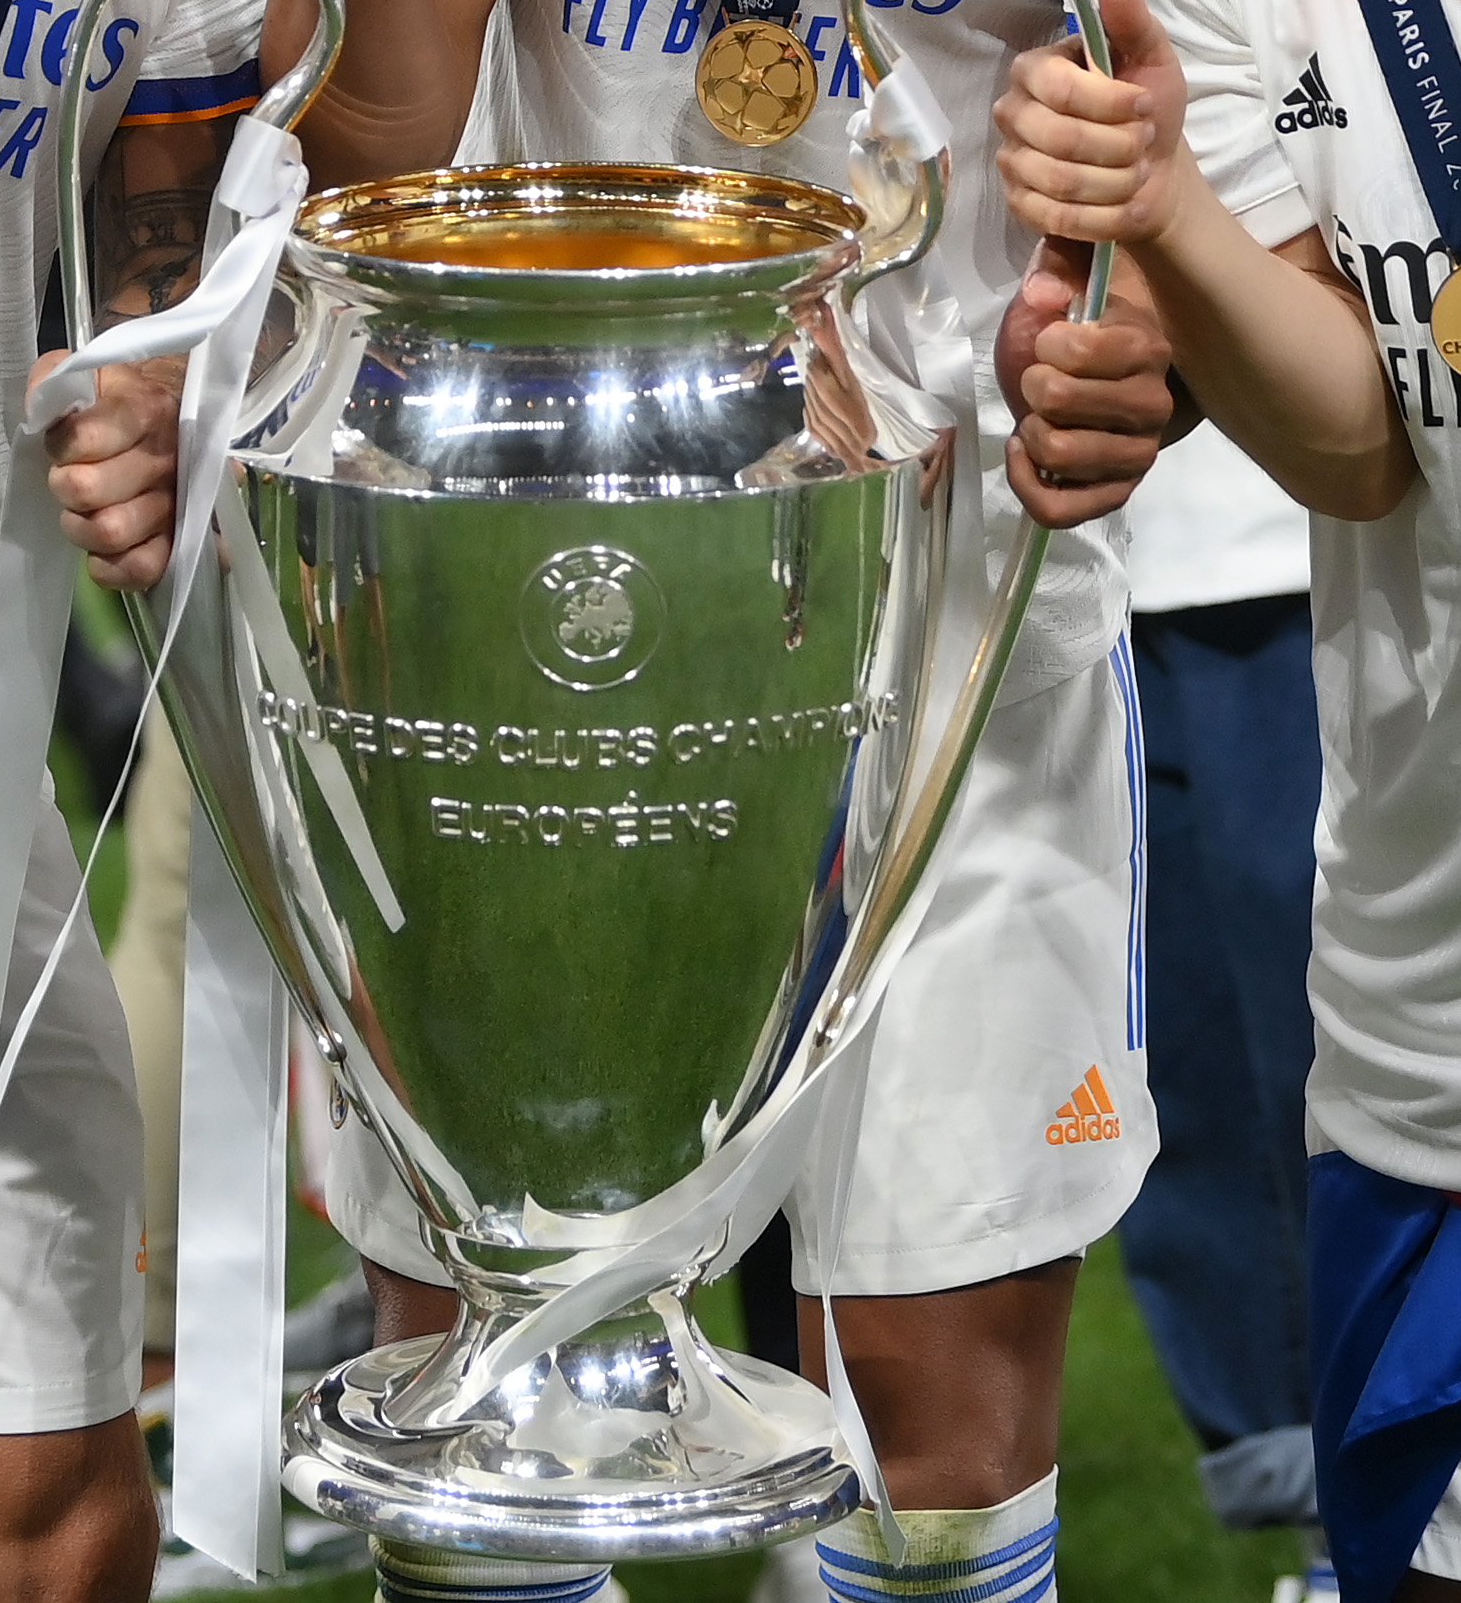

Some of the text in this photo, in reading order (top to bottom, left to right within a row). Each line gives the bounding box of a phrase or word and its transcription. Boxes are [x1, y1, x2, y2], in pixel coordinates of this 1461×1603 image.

[1416, 73, 1461, 155] FINAL
[257, 689, 377, 753] COUPE
[384, 716, 478, 766] DES
[490, 724, 658, 770] CLUBS
[1045, 1113, 1121, 1145] adidas
